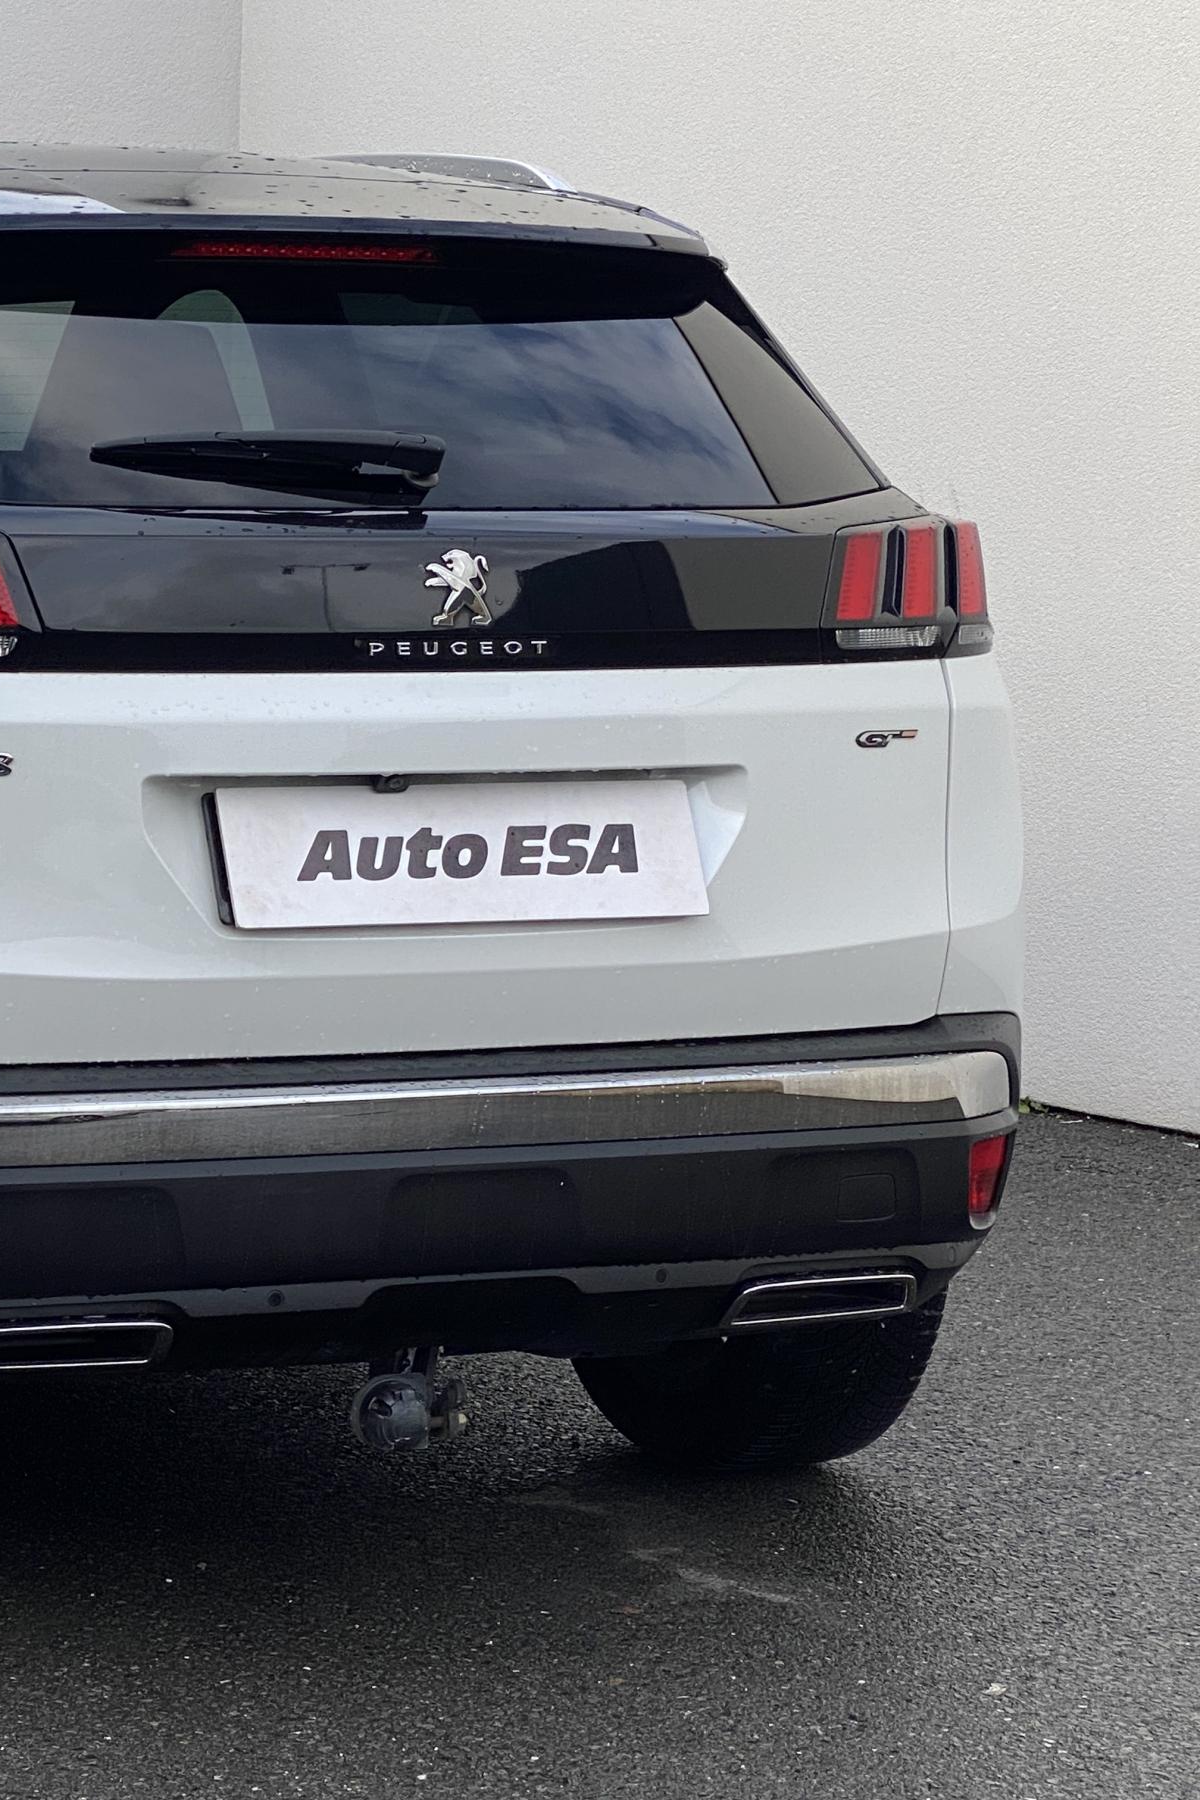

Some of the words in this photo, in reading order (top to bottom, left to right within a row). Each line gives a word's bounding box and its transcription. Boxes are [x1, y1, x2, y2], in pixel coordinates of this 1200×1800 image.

[368, 641, 547, 656] PEUGEOT
[855, 729, 918, 748] GT
[297, 827, 489, 881] Auto
[500, 823, 639, 876] ESA
